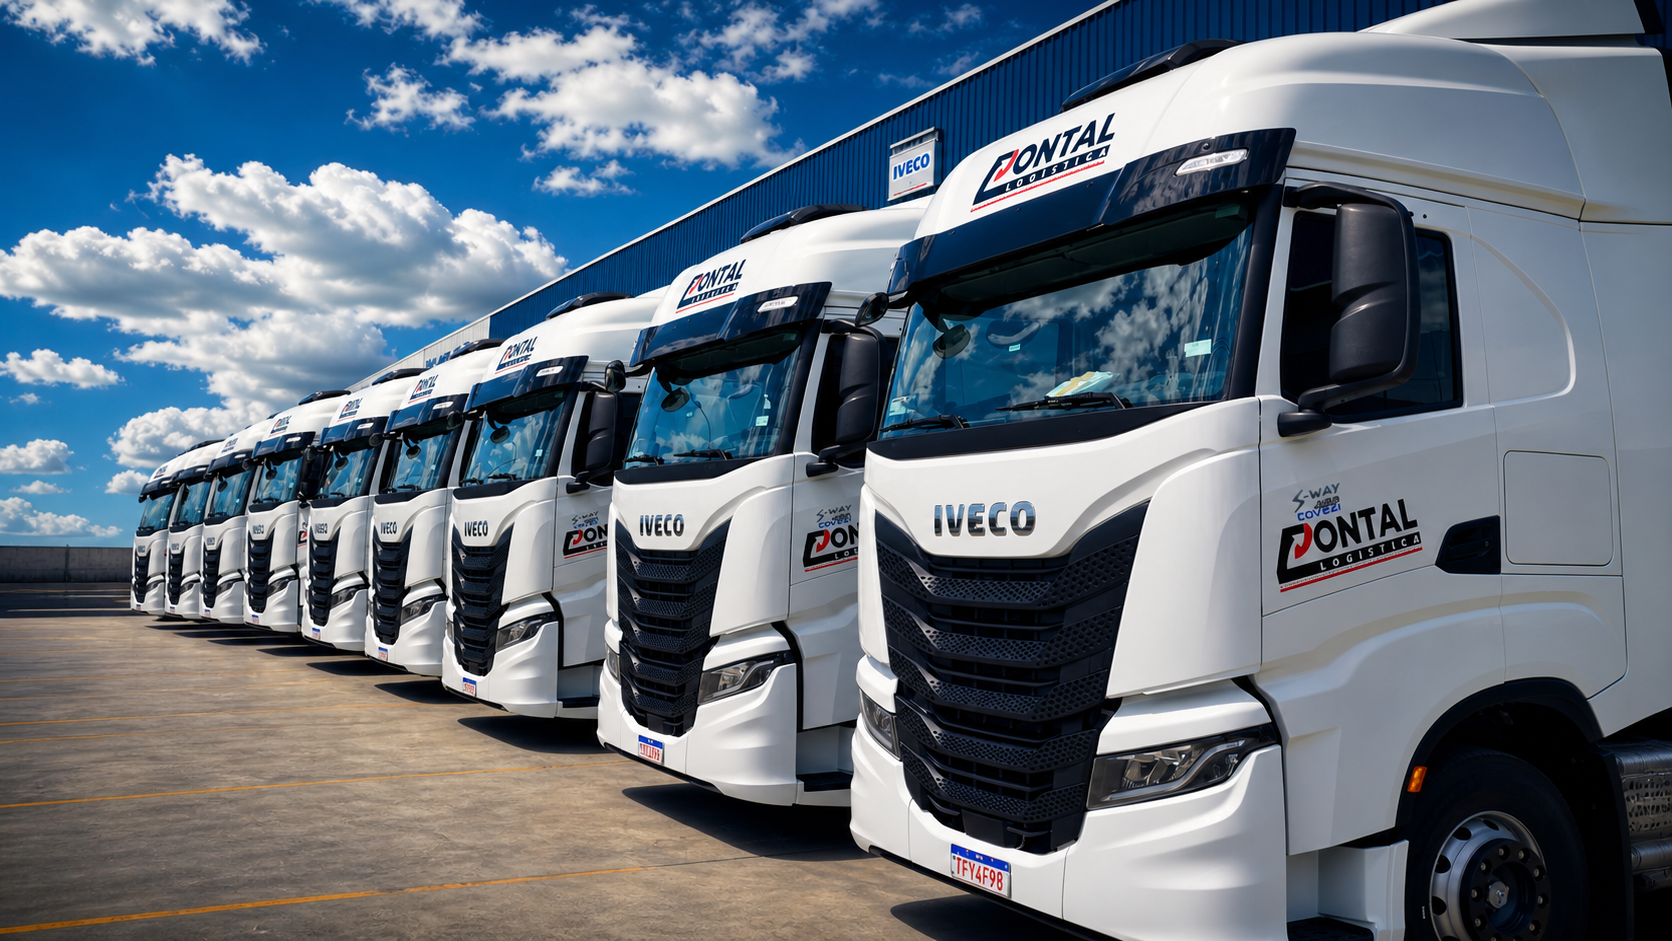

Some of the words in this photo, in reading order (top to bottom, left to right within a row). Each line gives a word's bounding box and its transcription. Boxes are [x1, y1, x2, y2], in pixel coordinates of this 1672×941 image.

[893, 152, 930, 180] IVECO
[1292, 483, 1340, 513] S-WAY
[464, 520, 488, 537] IVECO
[640, 513, 684, 537] IVECO
[934, 500, 1036, 537] IVECO
[1320, 535, 1420, 571] LOGISTICA
[956, 857, 1003, 891] TFY4F98
